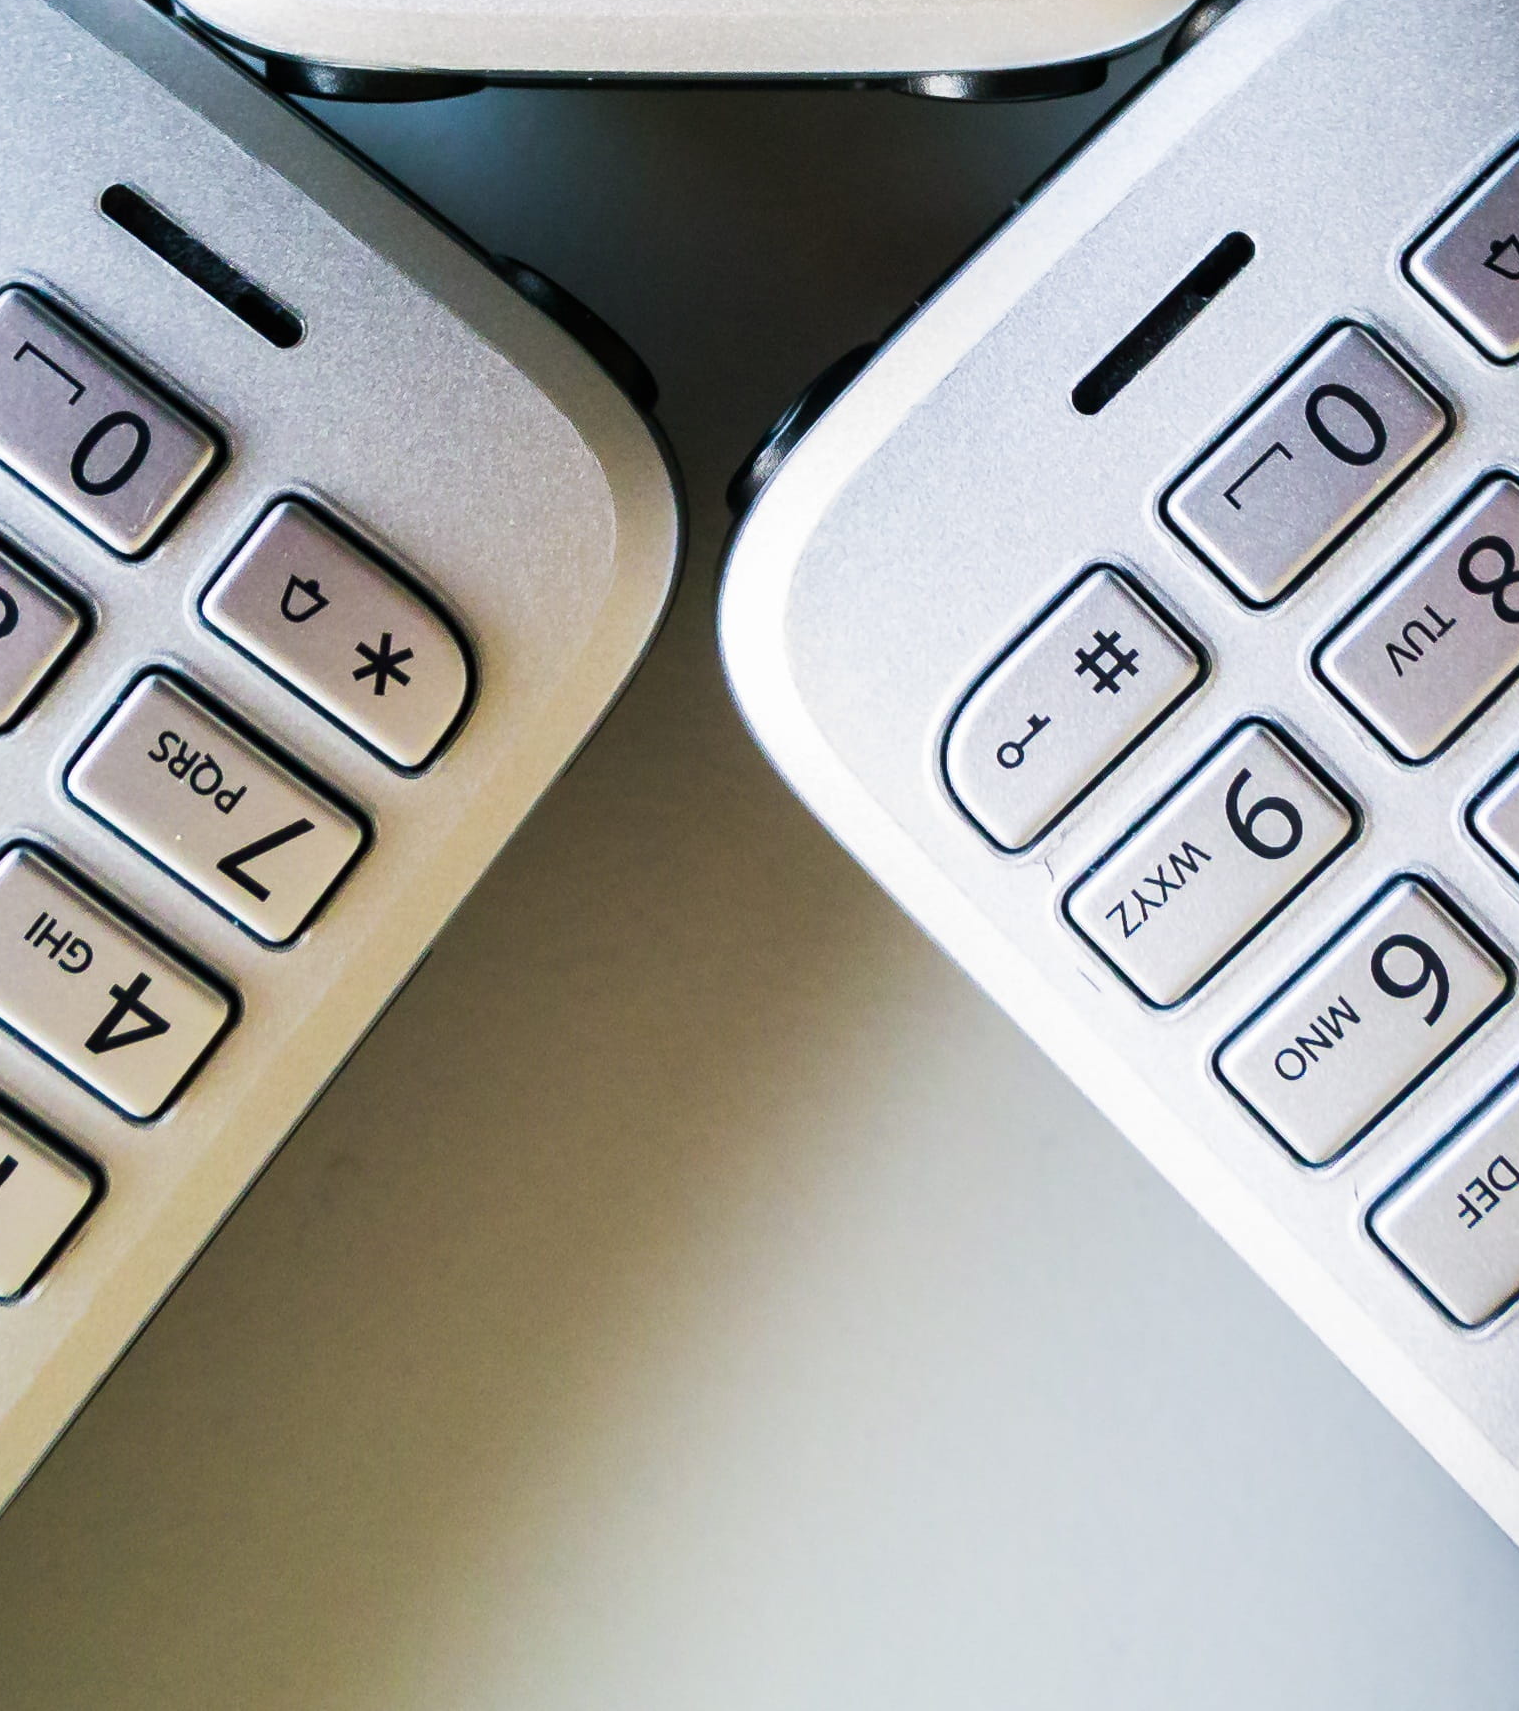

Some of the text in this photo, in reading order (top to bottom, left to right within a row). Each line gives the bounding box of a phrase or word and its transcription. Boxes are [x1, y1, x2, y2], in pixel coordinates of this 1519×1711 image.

[71, 411, 151, 495] 0
[1306, 384, 1386, 466] 0
[1386, 605, 1456, 676] TUV
[148, 729, 314, 901] 7 PQRS
[1106, 769, 1302, 938] 9 WXYZ
[24, 913, 170, 1054] 4 GHI
[1275, 935, 1449, 1080] 6 MNO
